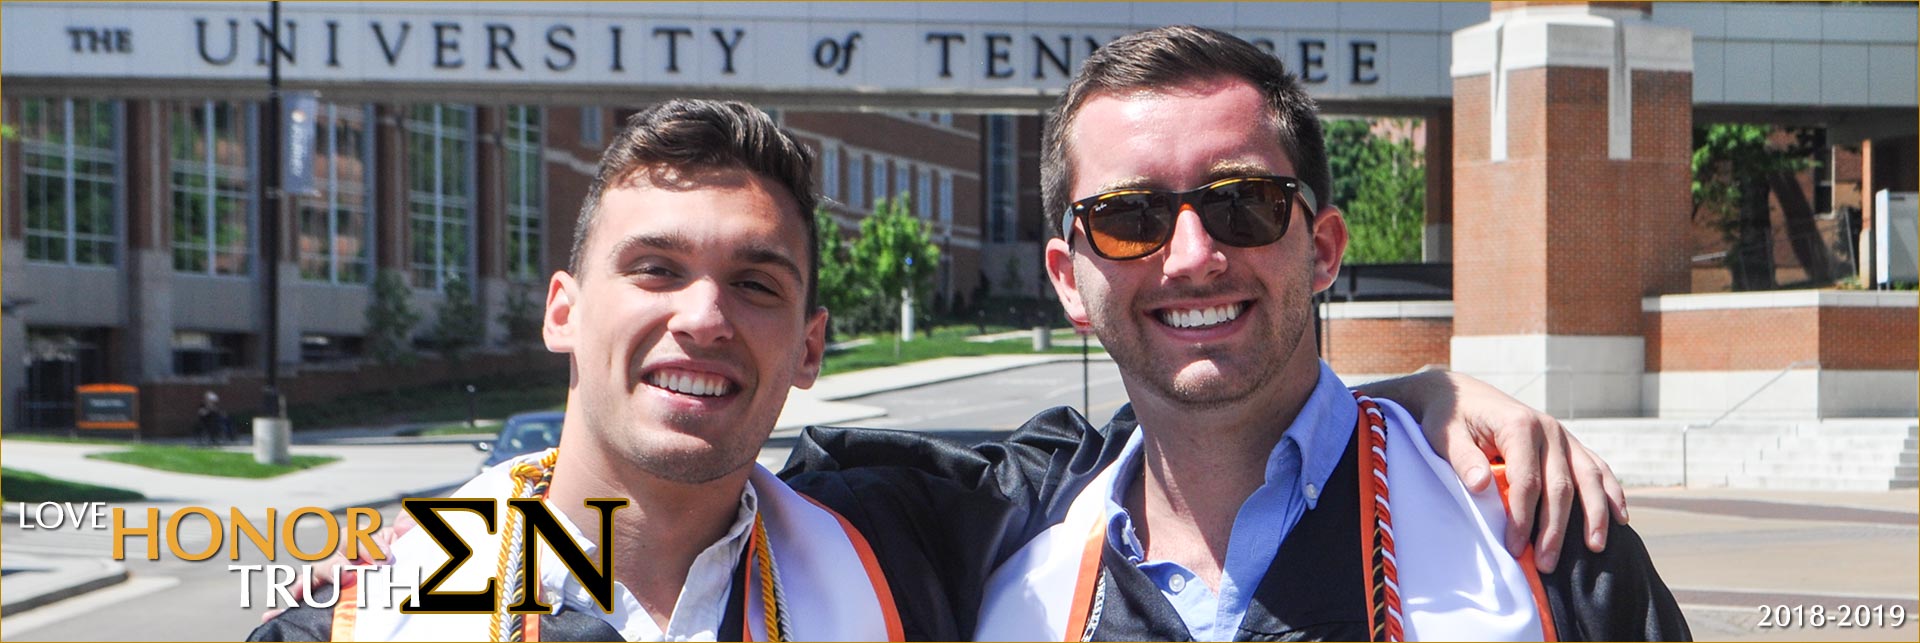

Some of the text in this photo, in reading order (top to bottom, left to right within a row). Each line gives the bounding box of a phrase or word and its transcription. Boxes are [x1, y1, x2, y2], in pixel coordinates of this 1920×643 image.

[67, 18, 1379, 84] THE UNIVERSITY of TENEE
